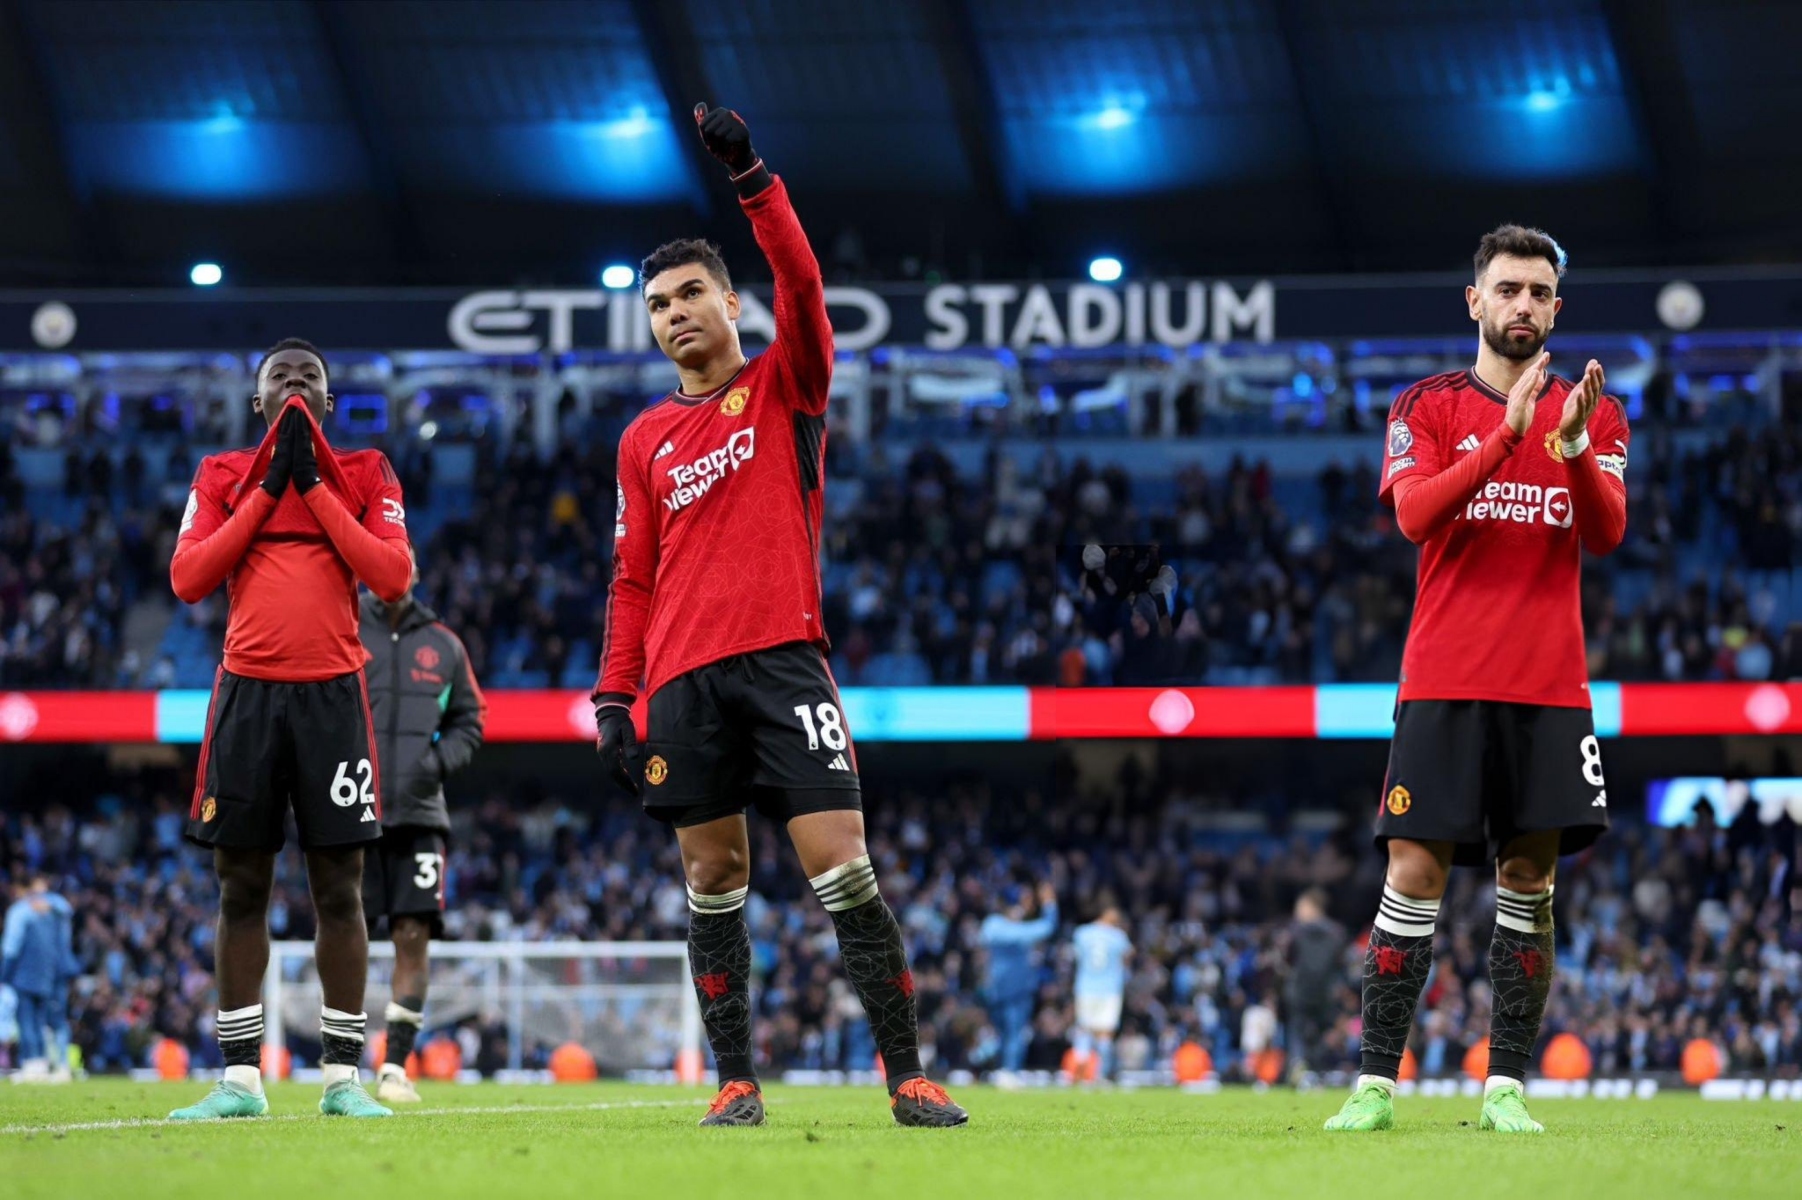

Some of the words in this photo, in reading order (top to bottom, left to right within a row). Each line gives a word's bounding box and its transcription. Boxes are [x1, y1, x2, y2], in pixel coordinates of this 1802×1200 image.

[924, 281, 1275, 350] STADIUM
[1455, 500, 1541, 524] iewer
[794, 702, 847, 751] 18
[330, 758, 375, 807] 62
[1580, 734, 1605, 787] 8
